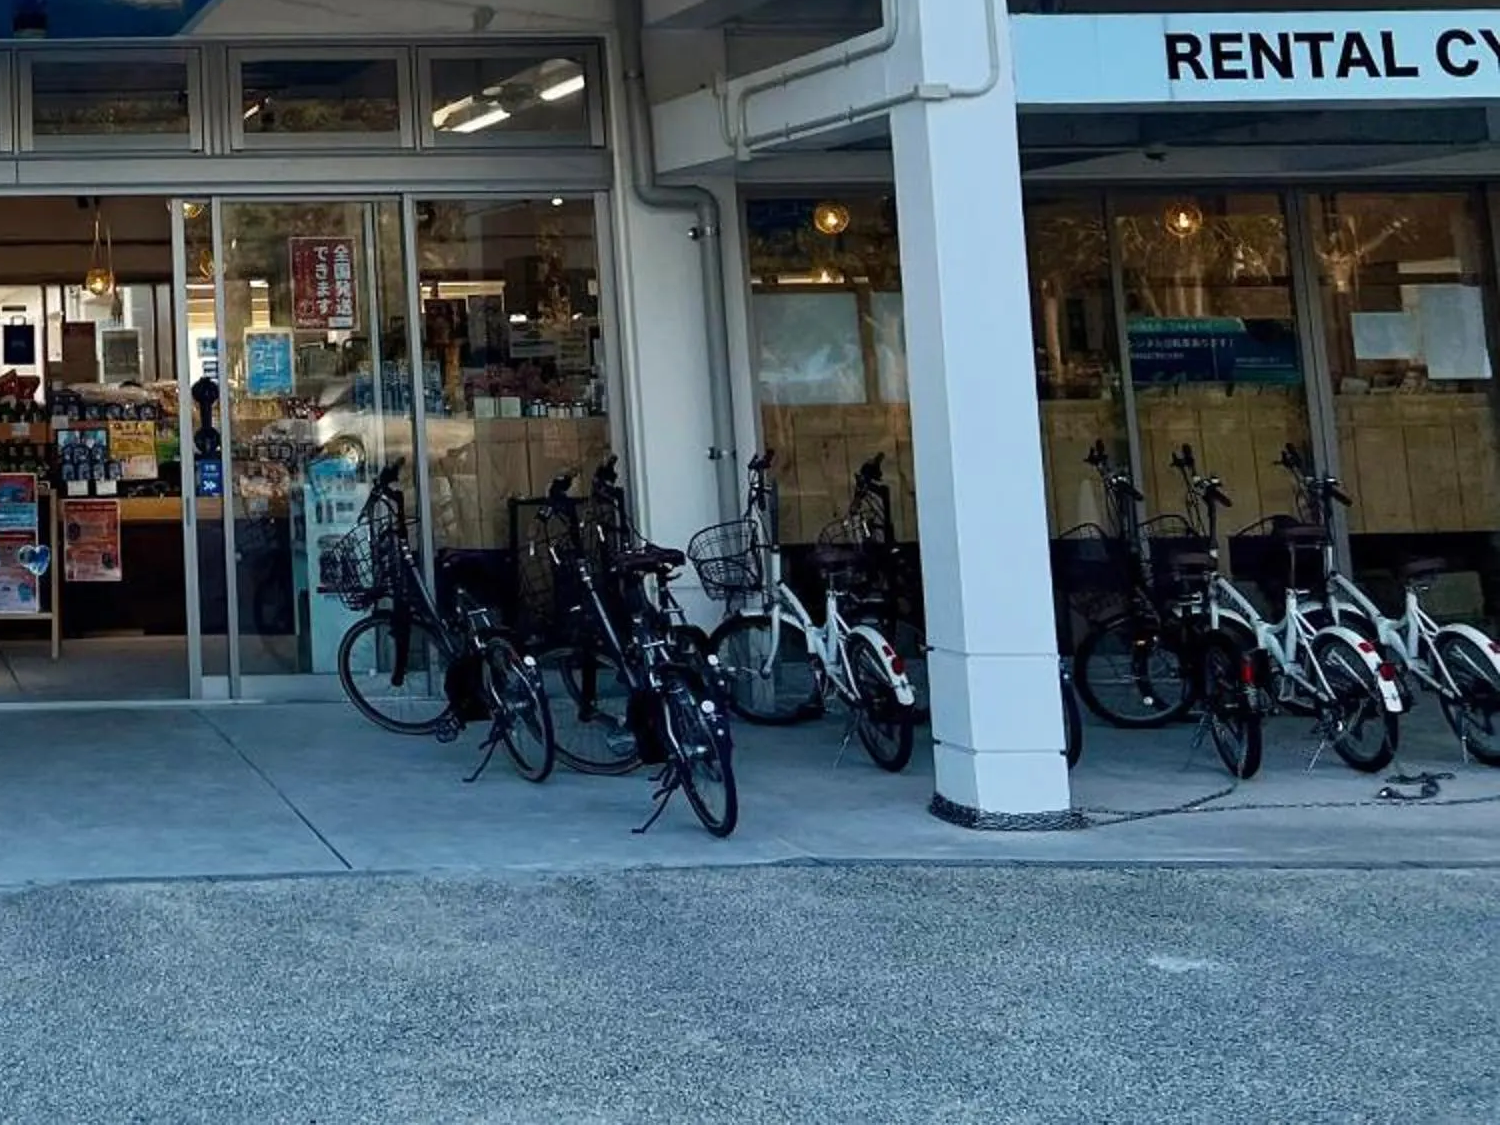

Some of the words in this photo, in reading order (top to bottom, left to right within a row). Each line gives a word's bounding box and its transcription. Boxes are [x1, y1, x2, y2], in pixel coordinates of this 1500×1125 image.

[1164, 30, 1419, 80] RENTAL
[314, 246, 332, 315] できます
[334, 244, 352, 315] 全国発送
